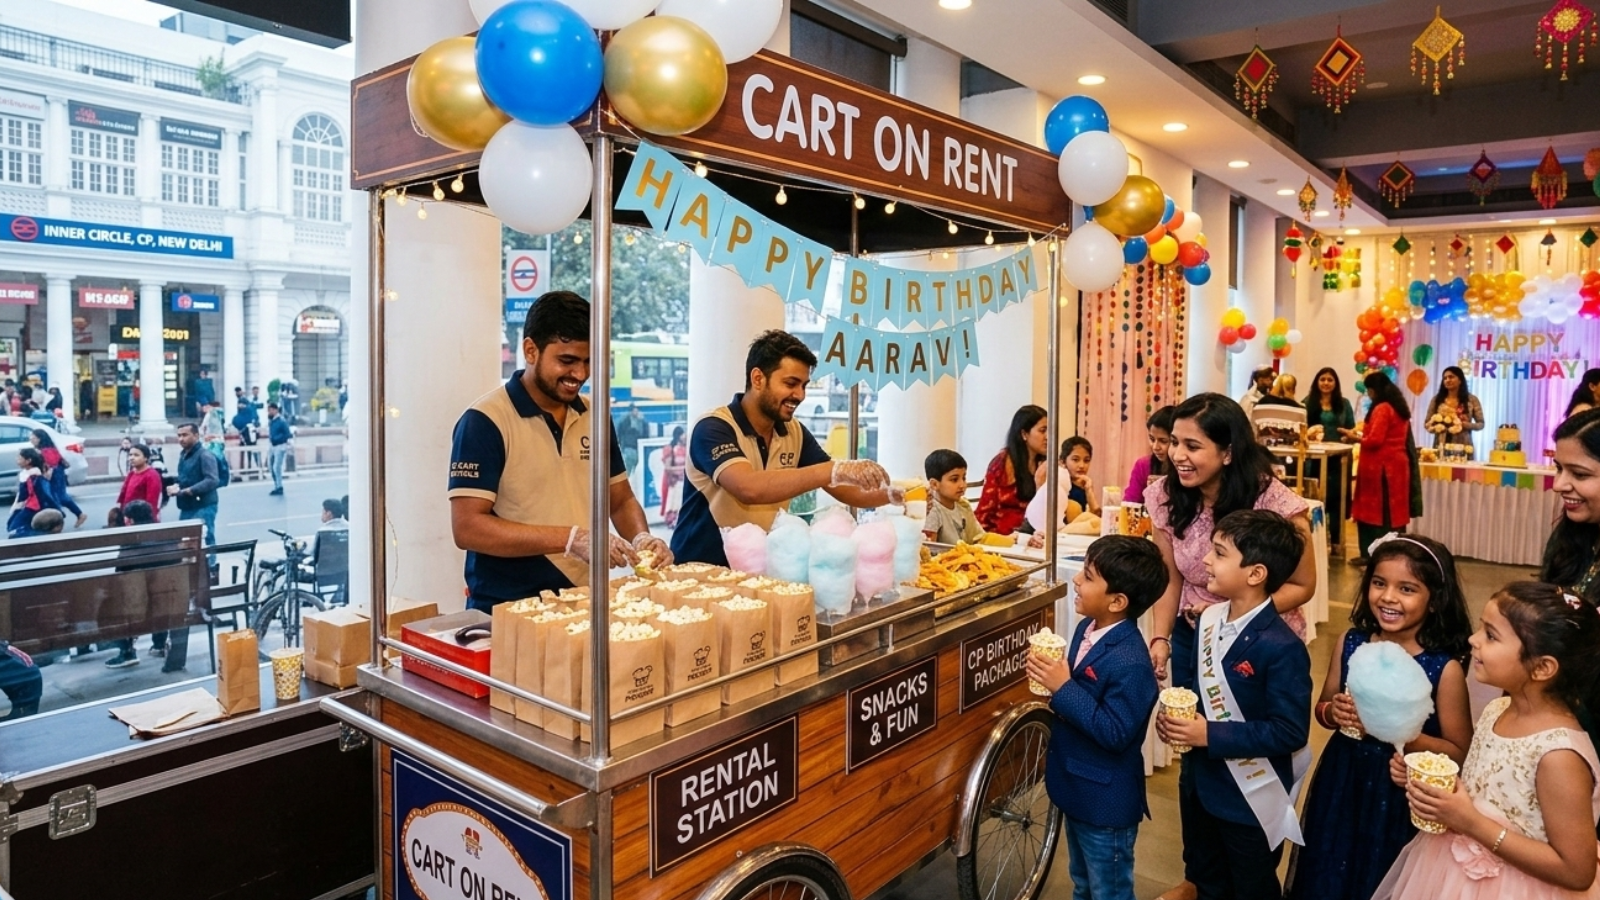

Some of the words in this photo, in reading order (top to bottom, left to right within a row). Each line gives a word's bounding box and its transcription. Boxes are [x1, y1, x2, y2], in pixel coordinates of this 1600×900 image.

[742, 73, 861, 160] CART
[873, 115, 930, 181] ON
[944, 136, 1018, 203] RENT
[44, 224, 86, 240] INNER
[88, 229, 136, 246] CIRCLE,
[137, 234, 156, 248] CP,
[158, 235, 187, 249] NEW
[189, 238, 223, 252] DELHI
[635, 158, 825, 291] HAPPY
[850, 249, 1032, 313] BIRTHDAY
[825, 329, 970, 374] AARAV!
[1476, 332, 1564, 353] HAPPY
[967, 647, 985, 671] CP
[987, 622, 1040, 662] BIRTHDAY
[861, 672, 928, 722] SNACKS
[870, 721, 882, 746] &
[887, 703, 919, 739] FUN
[681, 742, 777, 808] RENTAL
[676, 770, 779, 845] STATION
[411, 838, 456, 889] CART
[460, 866, 486, 900] ON
